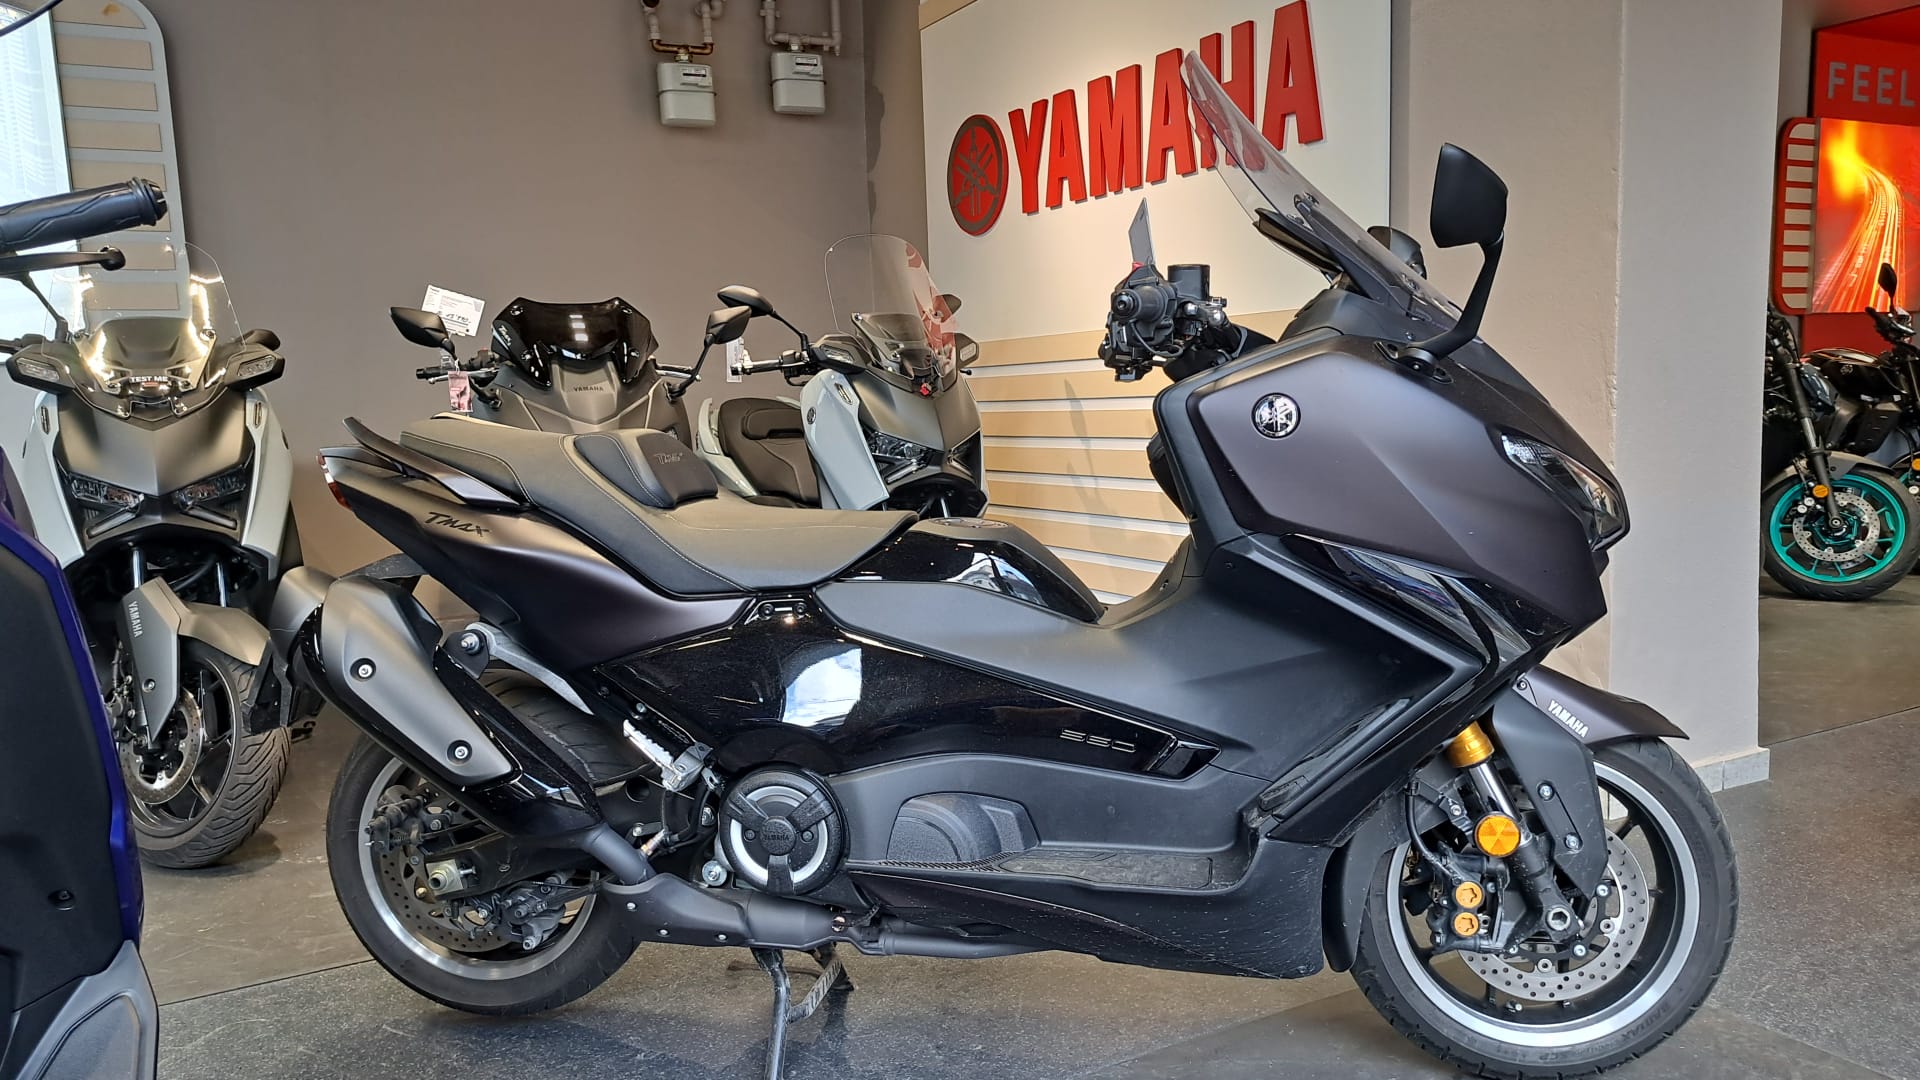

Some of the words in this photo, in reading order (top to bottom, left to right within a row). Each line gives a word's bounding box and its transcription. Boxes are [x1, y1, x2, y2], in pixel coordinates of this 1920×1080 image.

[1827, 61, 1916, 107] FEEL
[1007, 0, 1324, 215] YAMAHA
[128, 600, 143, 638] YAMAHA
[1548, 699, 1589, 738] YAMAHA
[1060, 728, 1136, 753] 560
